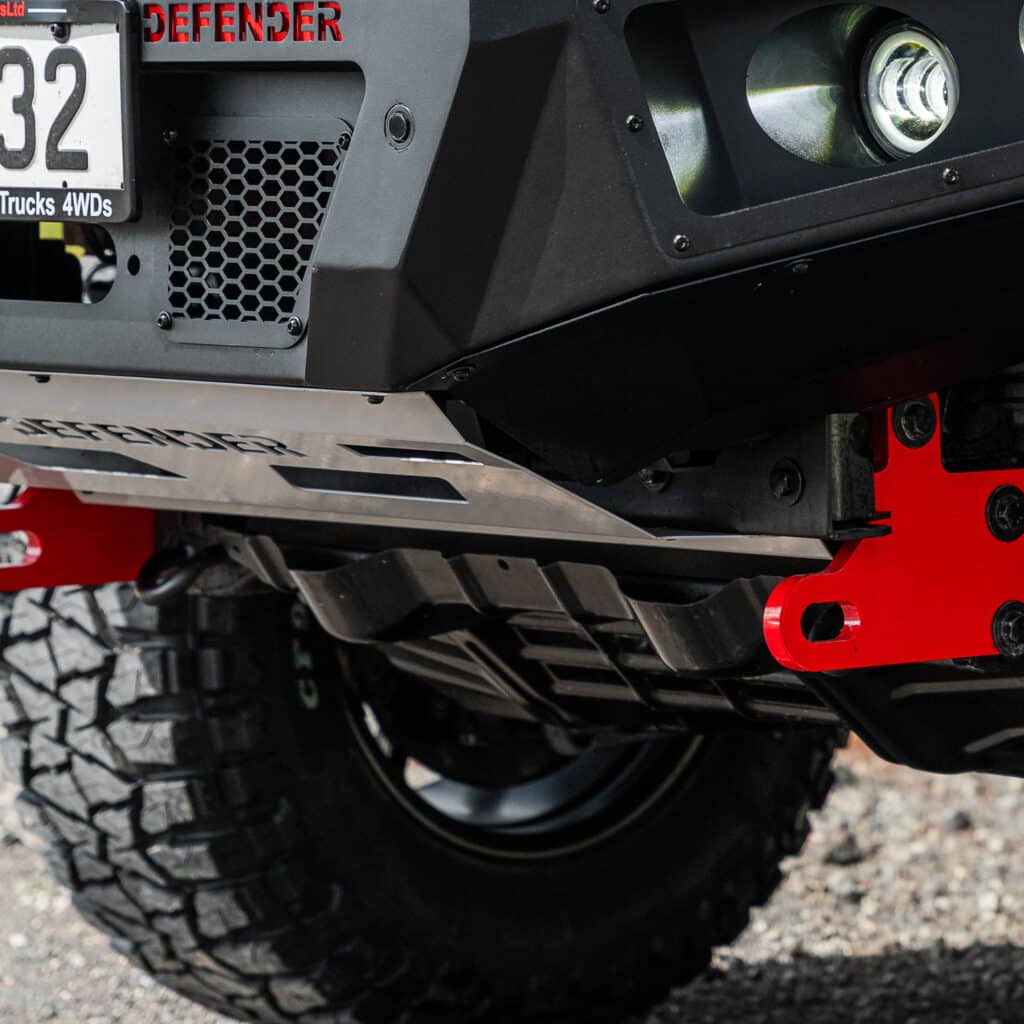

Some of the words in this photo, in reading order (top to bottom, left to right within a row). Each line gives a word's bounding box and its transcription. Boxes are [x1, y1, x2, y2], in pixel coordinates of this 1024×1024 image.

[143, 1, 344, 43] DEFENDER
[0, 46, 89, 170] 32
[0, 190, 55, 216] Trucks
[62, 191, 113, 217] 4WDs
